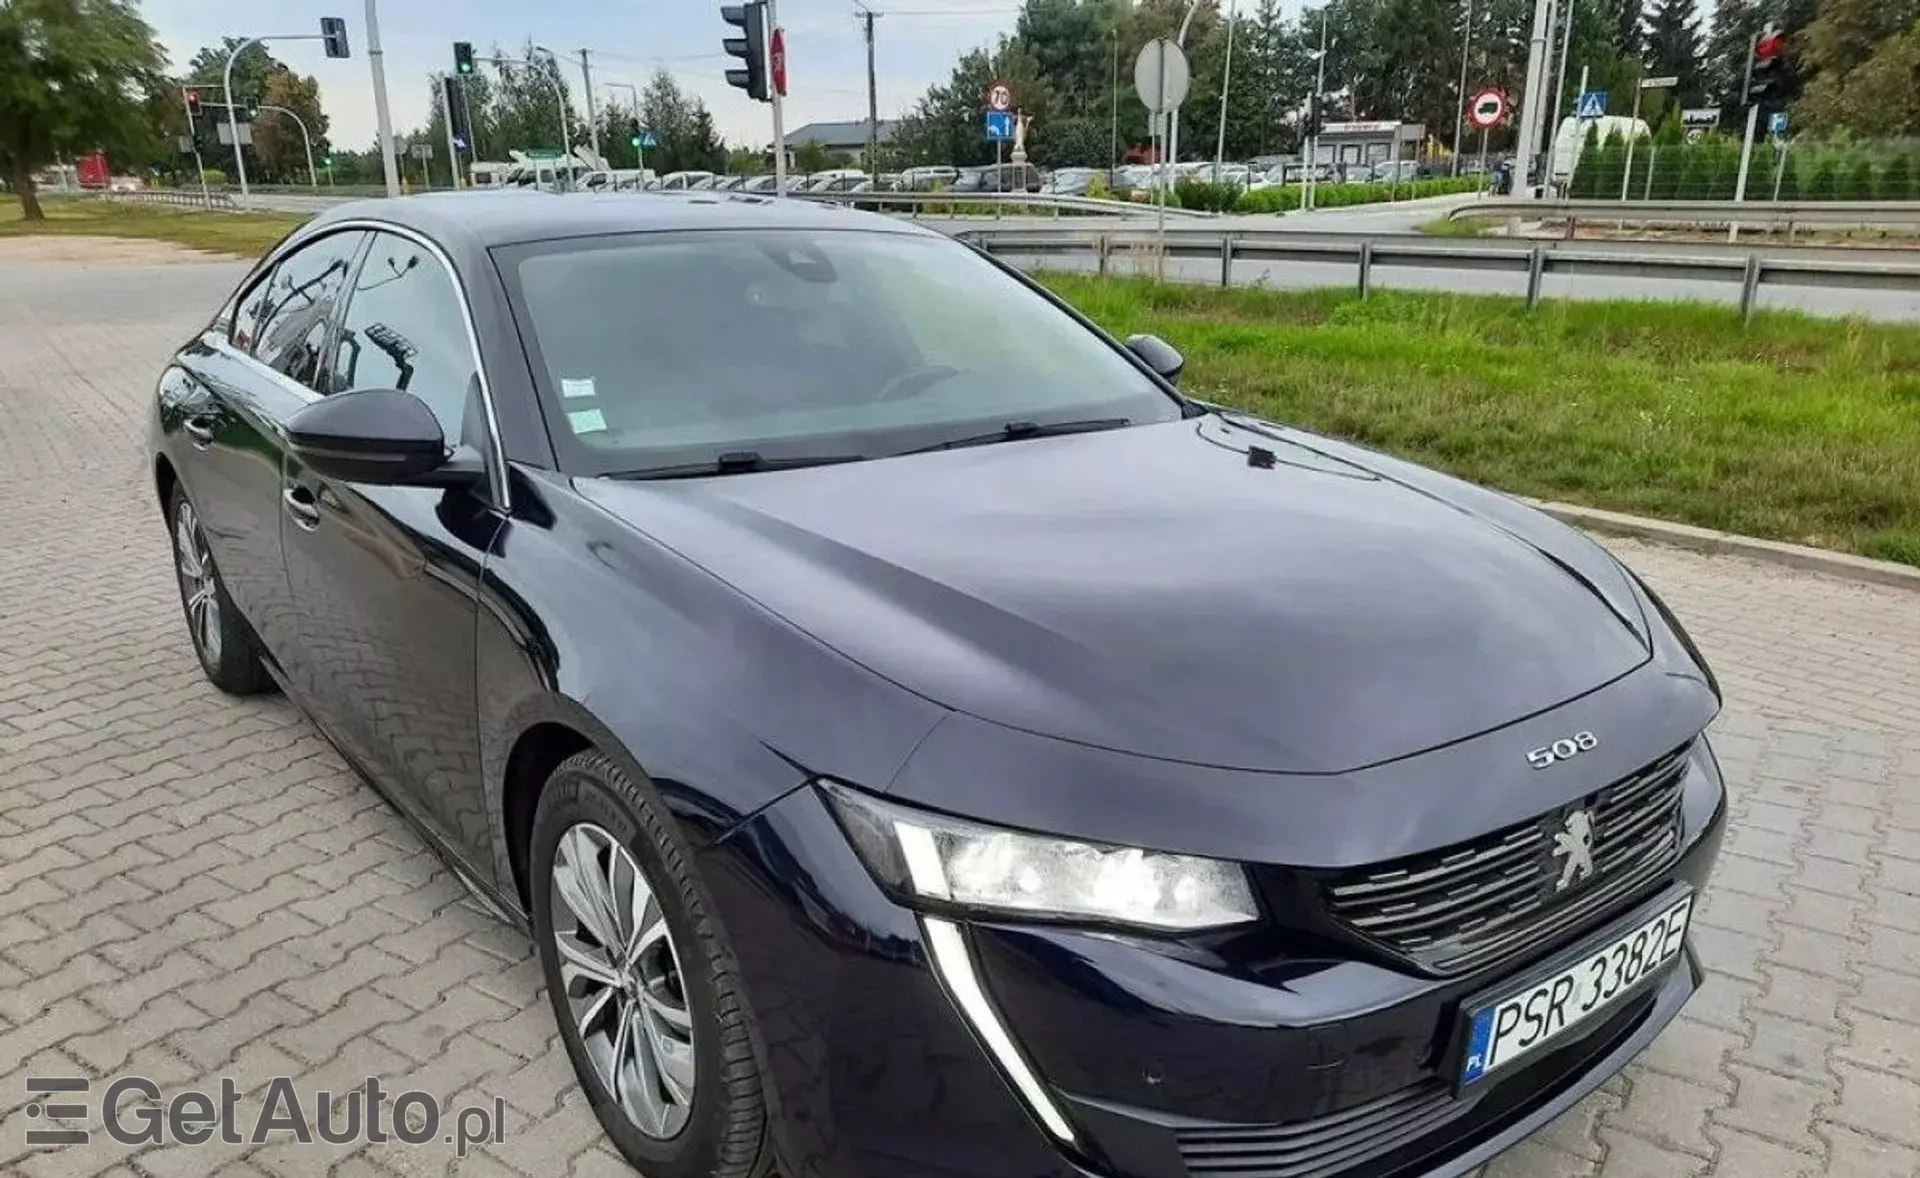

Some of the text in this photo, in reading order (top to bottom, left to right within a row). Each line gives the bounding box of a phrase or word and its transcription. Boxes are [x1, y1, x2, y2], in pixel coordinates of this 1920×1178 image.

[1525, 731, 1598, 769] 508
[1488, 902, 1688, 1065] PSR 3382E
